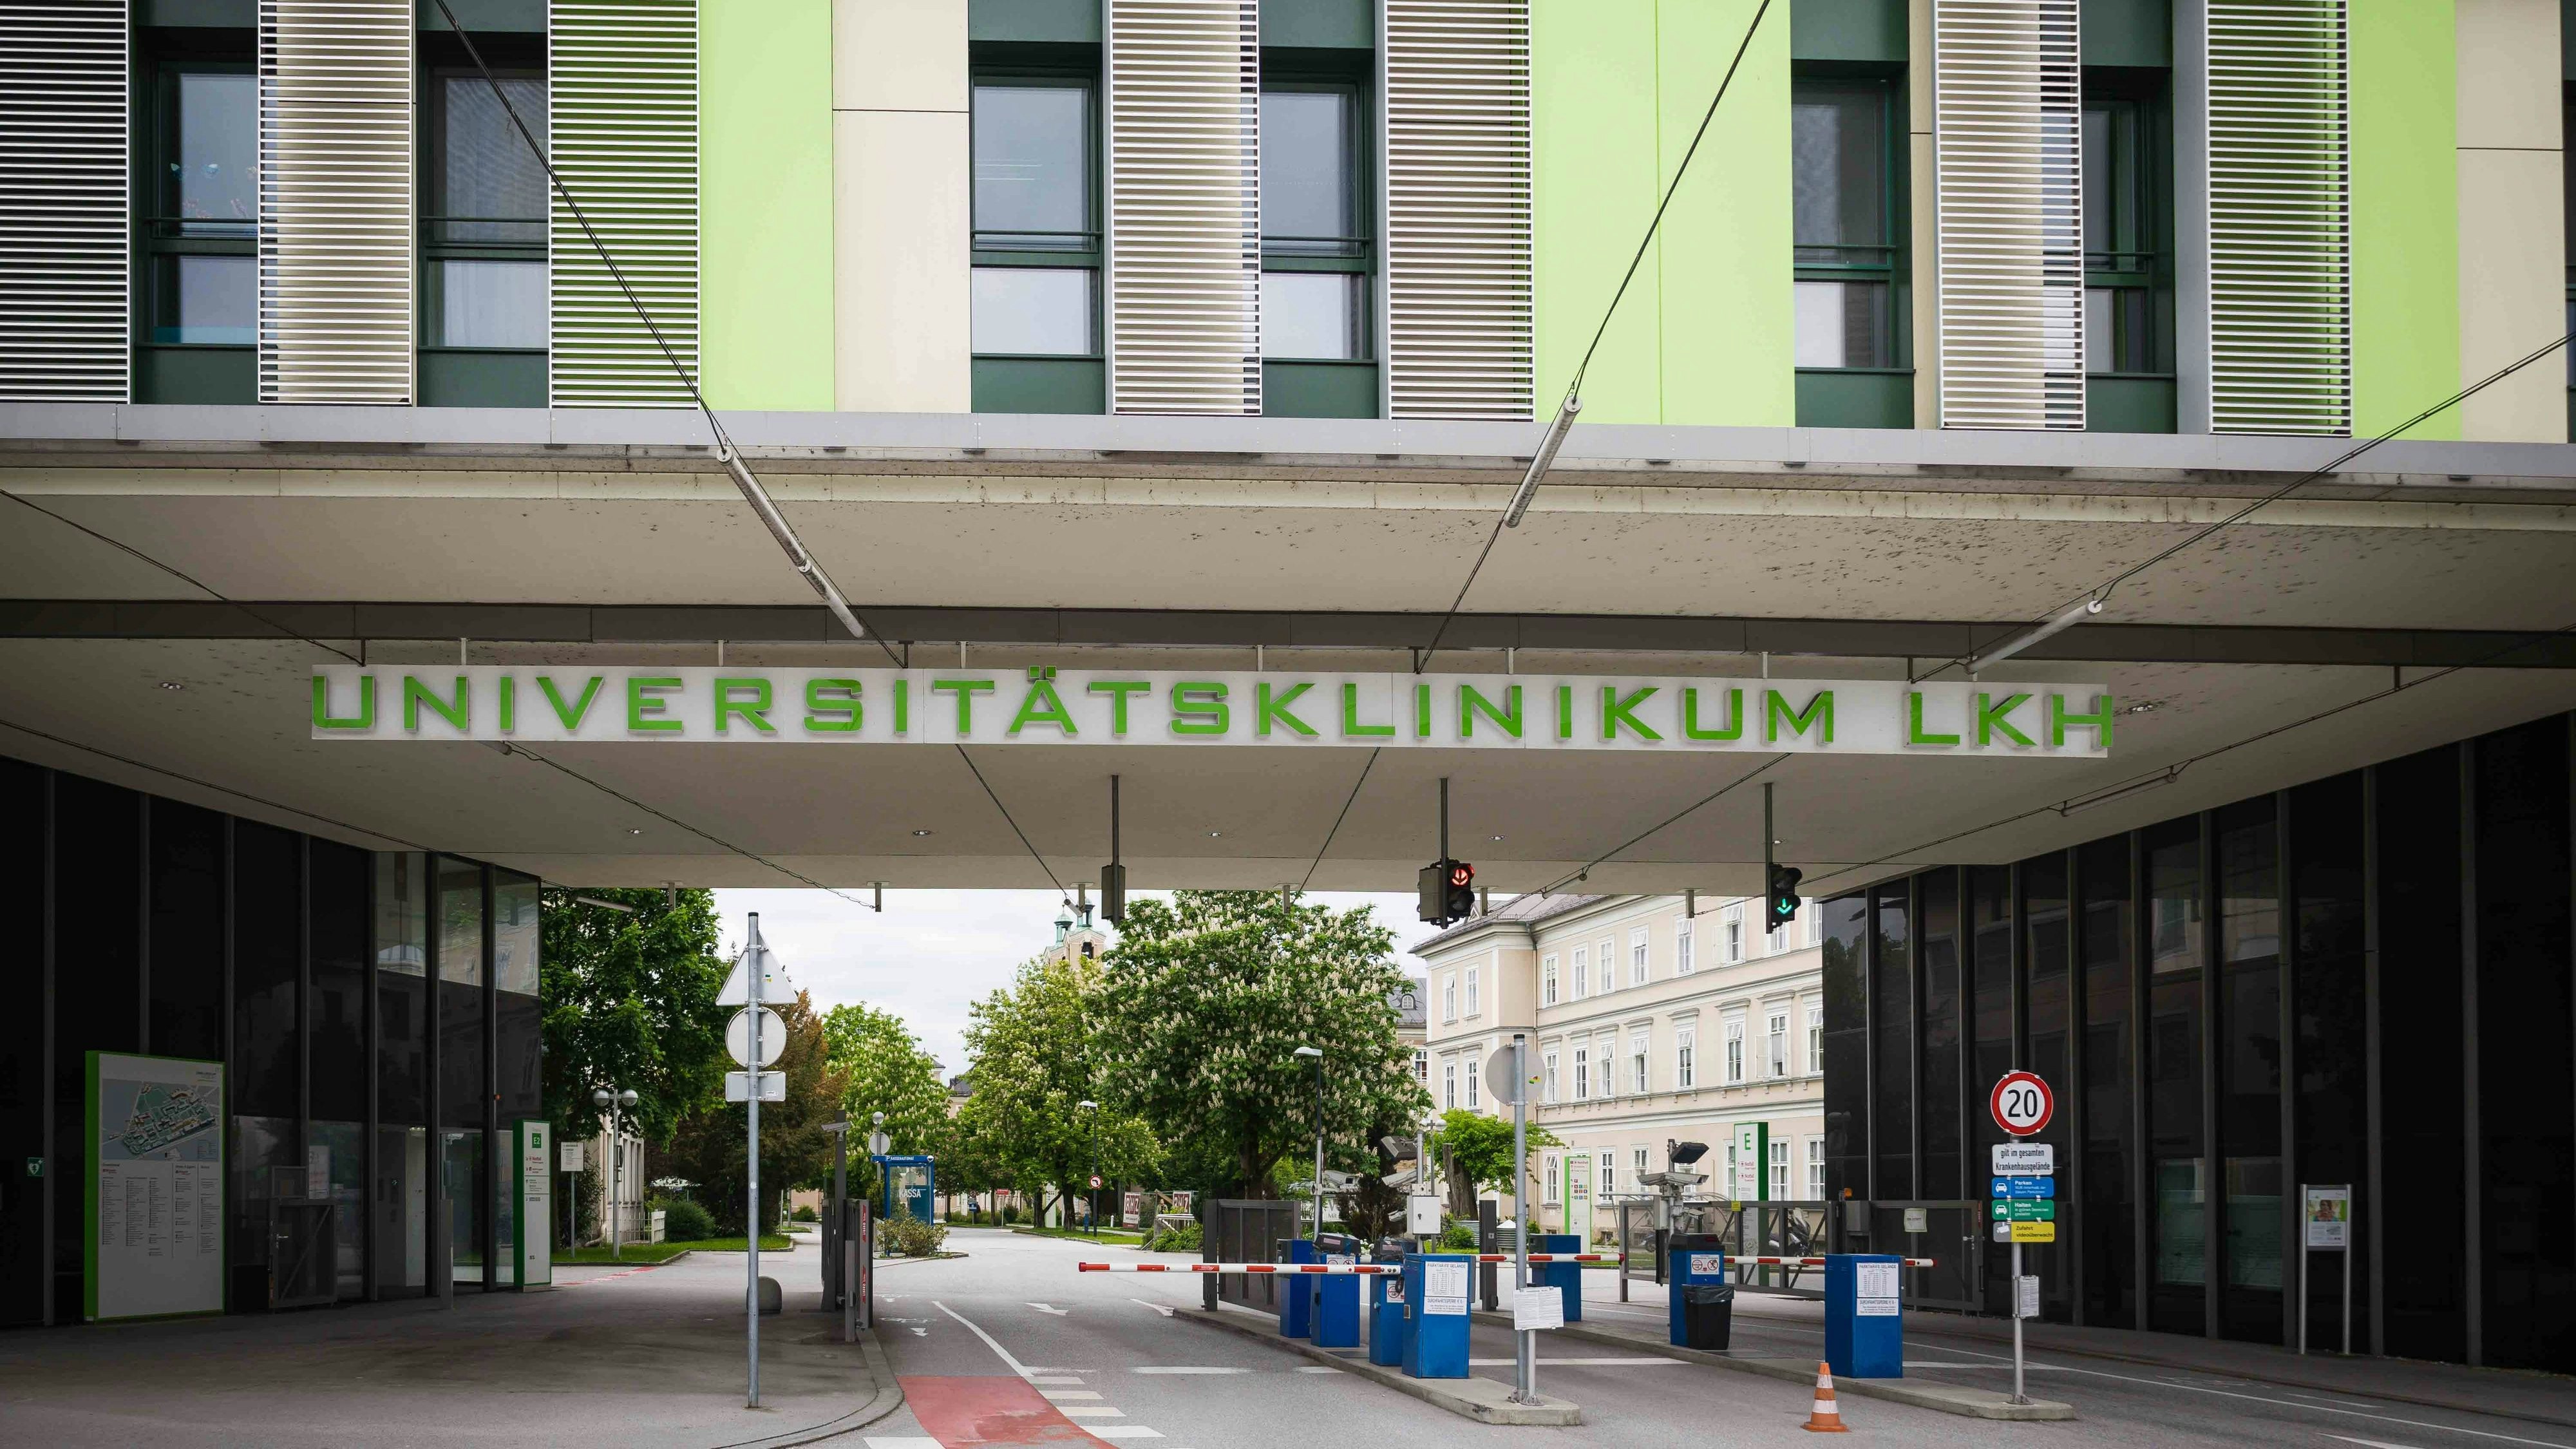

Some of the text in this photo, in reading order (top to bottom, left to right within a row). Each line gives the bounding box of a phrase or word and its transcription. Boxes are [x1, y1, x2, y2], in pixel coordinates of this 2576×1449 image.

[312, 666, 2113, 748] UNIVERSITÄTSKLINIKUM LKH
[2007, 1089, 2038, 1118] 20
[1744, 1133, 1751, 1150] E
[2000, 1148, 2045, 1159] gilt im gesamten
[1996, 1162, 2050, 1172] Krankenhausgelände
[898, 1189, 922, 1198] KASSA
